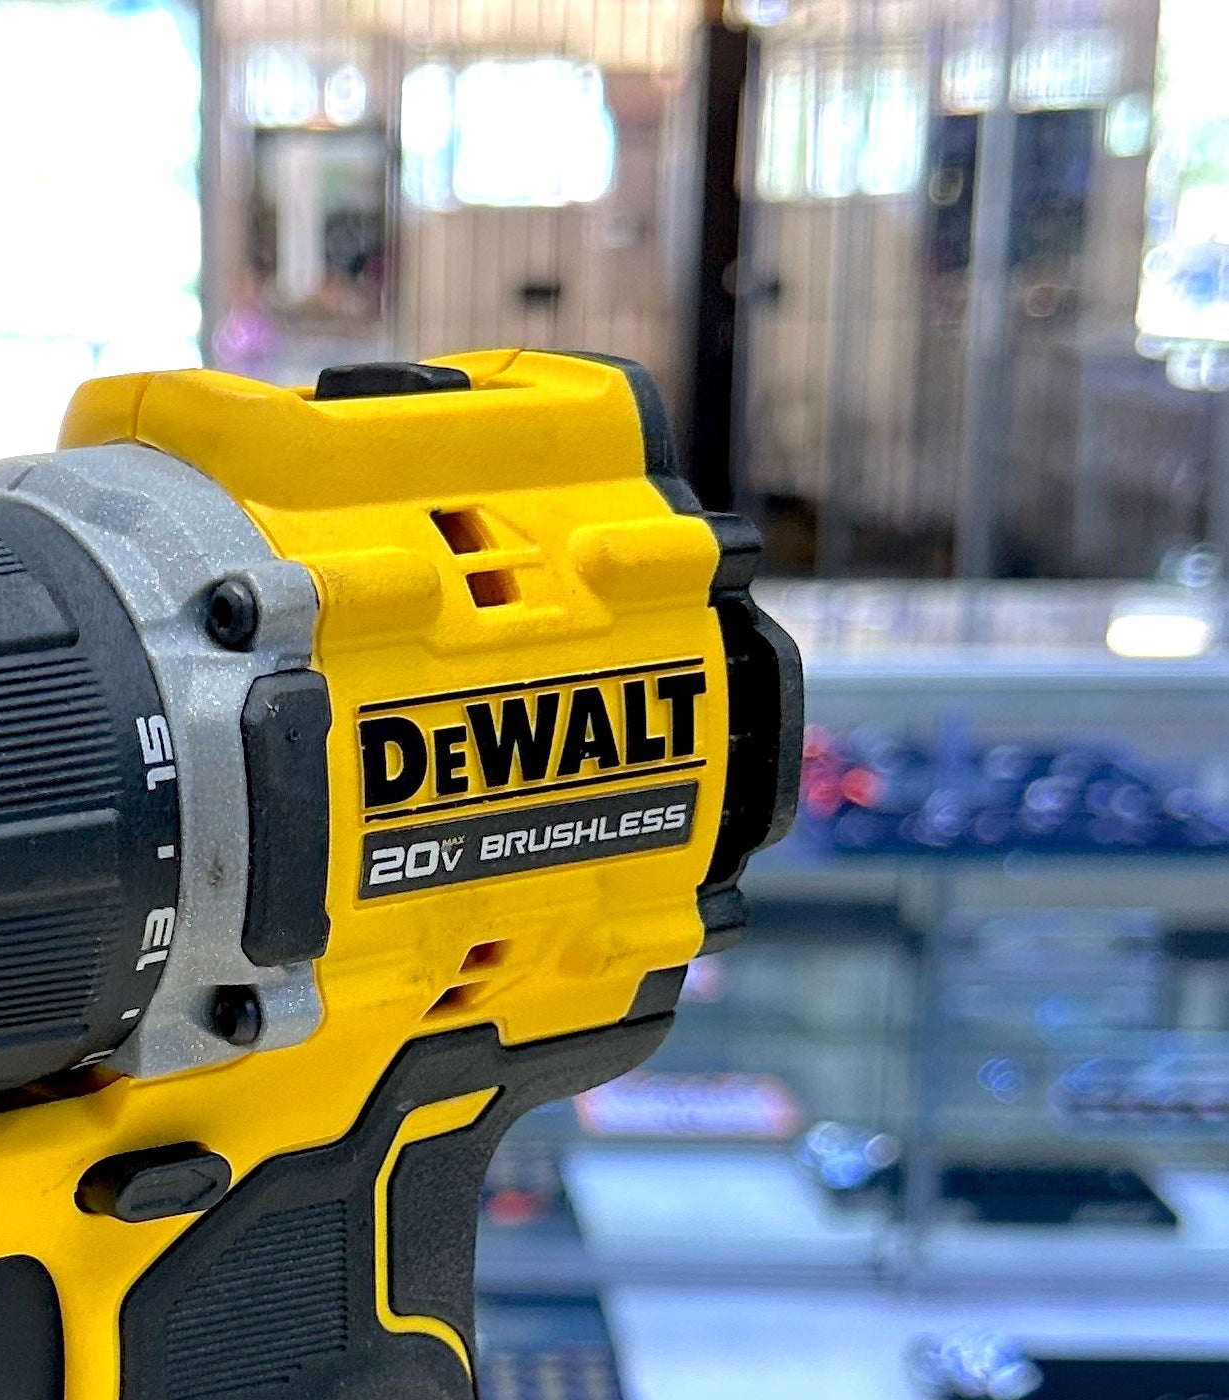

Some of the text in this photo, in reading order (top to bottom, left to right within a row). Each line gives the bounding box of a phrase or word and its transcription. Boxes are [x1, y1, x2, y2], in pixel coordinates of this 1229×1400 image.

[135, 714, 177, 791] 15
[480, 803, 687, 861] BRUSHLESS
[135, 906, 177, 972] 13
